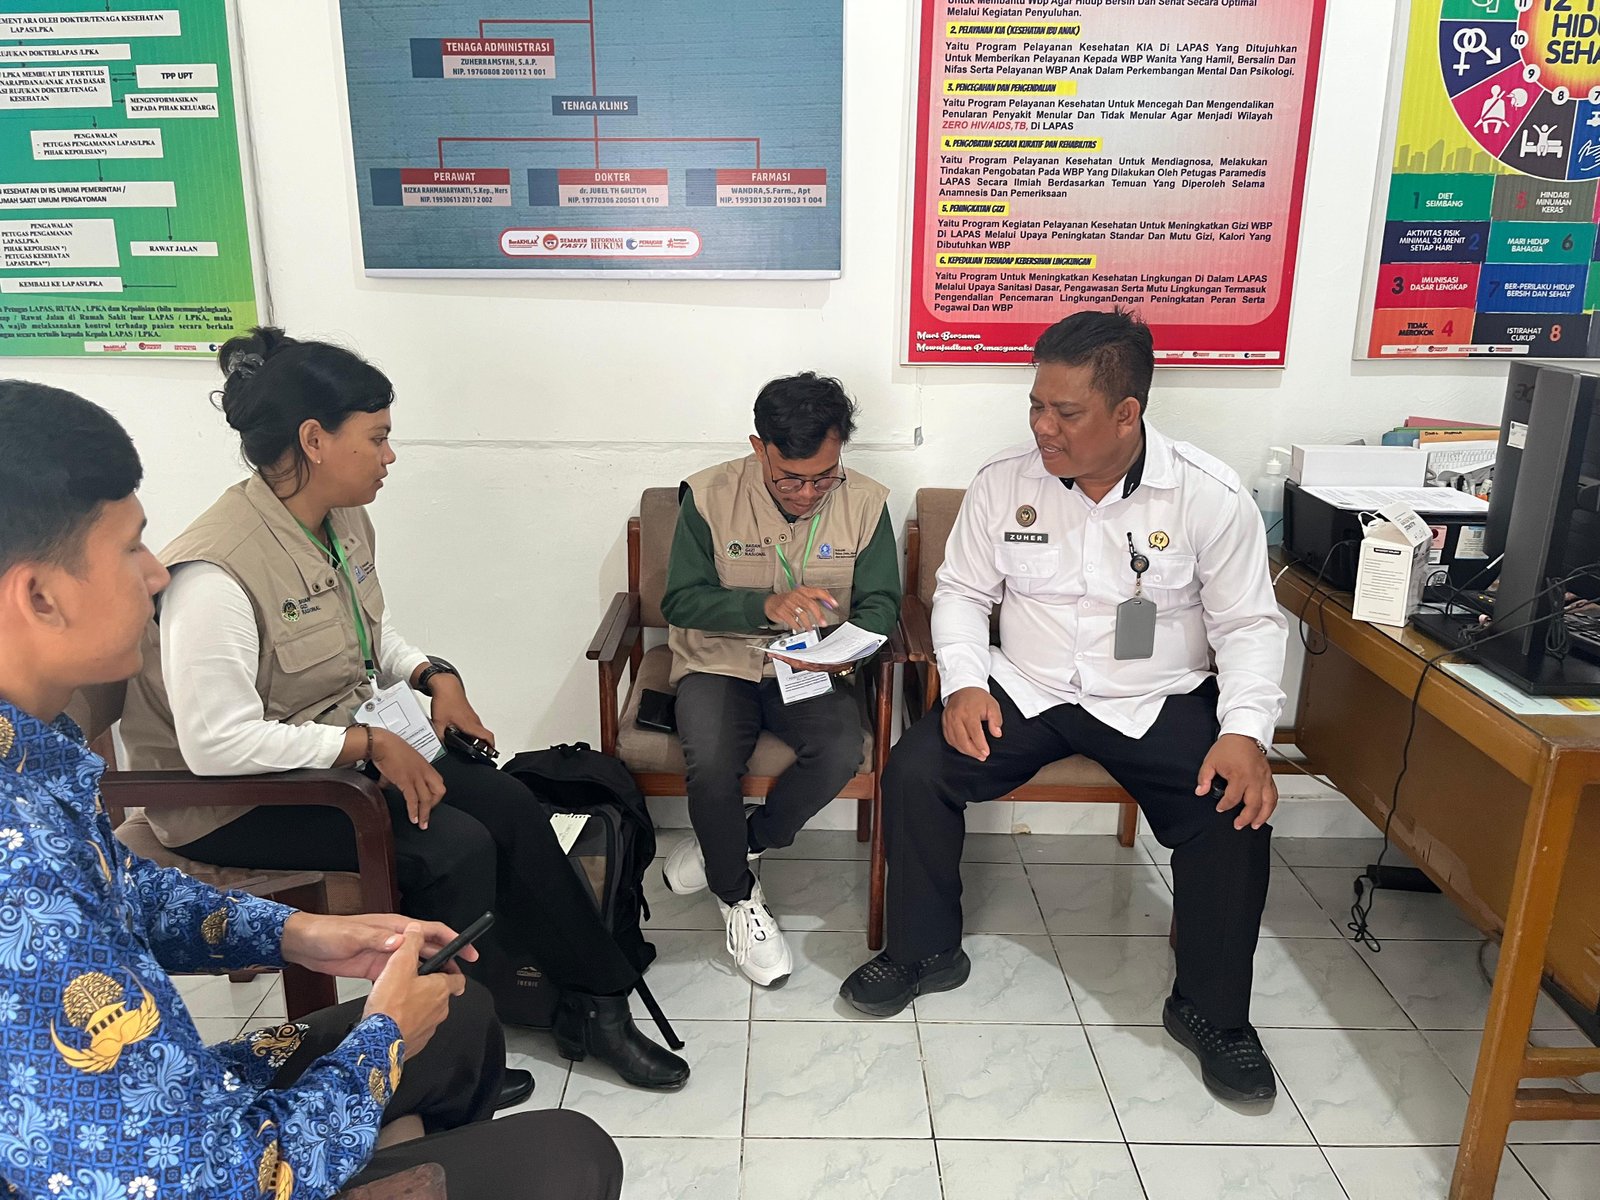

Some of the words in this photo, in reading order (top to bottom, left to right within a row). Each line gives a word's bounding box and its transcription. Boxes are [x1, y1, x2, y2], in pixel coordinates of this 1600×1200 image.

[947, 8, 980, 16] Melalui
[982, 8, 1023, 18] Kegiatan
[1025, 8, 1082, 18] Penyuluhan.
[958, 26, 993, 35] PELAYANAN
[994, 26, 1006, 34] KIA
[1006, 25, 1046, 36] (KESEHATAN
[1046, 26, 1058, 35] IBU
[1058, 25, 1081, 36] ANAK)
[1552, 13, 1600, 38] HID
[1513, 34, 1525, 45] 10
[446, 42, 482, 52] TENAGA
[484, 42, 550, 52] ADMINISTRASI
[946, 42, 970, 51] Yaitu
[976, 42, 1017, 53] Program
[1023, 42, 1073, 53] Pelayanan
[1079, 43, 1130, 52] Kesehatan
[1136, 43, 1153, 51] KIA
[1159, 43, 1170, 52] Di
[1176, 43, 1209, 52] LAPAS
[1215, 43, 1239, 54] Yang
[1246, 44, 1298, 55] Ditujuhkan
[461, 58, 517, 66] ZUHERRAMSYAH,
[518, 58, 537, 66] S.A.P.
[945, 54, 972, 63] Untuk
[974, 54, 1030, 63] Memberikan
[1033, 54, 1081, 66] Pelayanan
[1083, 54, 1118, 66] Kepada
[1121, 55, 1143, 63] WBP
[1146, 55, 1177, 64] Wanita
[1179, 55, 1203, 66] Yang
[1206, 55, 1234, 65] Hamil,
[1237, 55, 1275, 64] Bersalin
[1278, 56, 1296, 65] Dan
[161, 72, 176, 80] TPP
[178, 72, 193, 80] UPT
[453, 68, 466, 76] NIP.
[501, 68, 526, 76] 200112
[528, 68, 532, 76] 1
[533, 68, 546, 76] 001
[1528, 68, 1535, 79] 9
[1557, 90, 1565, 101] 8
[131, 104, 157, 112] KEPADA
[158, 104, 179, 112] PIHAK
[180, 104, 215, 112] KELUARGA
[562, 101, 597, 111] TENAGA
[599, 101, 629, 111] KLINIS
[942, 121, 968, 129] ZERO
[1031, 122, 1041, 130] Di
[1042, 122, 1074, 130] LAPAS
[434, 172, 476, 182] PERAWAT
[594, 172, 631, 182] DOKTER
[751, 172, 791, 182] FARMASI
[473, 187, 494, 195] S.Kep.,
[798, 187, 811, 195] Apt
[720, 196, 734, 204] NIP.
[735, 196, 772, 204] 19930130
[773, 196, 801, 204] 201903
[802, 196, 806, 204] 1
[807, 196, 823, 204] 004
[1413, 192, 1420, 209] 1
[1425, 200, 1464, 208] SEIMBANG
[1515, 192, 1528, 209] 5
[937, 241, 987, 249] Dibutuhkan
[989, 241, 1011, 249] WBP
[1468, 233, 1480, 250] 2
[1561, 234, 1574, 251] 6
[1391, 277, 1404, 295] 3
[1488, 281, 1500, 298] 7
[1507, 290, 1531, 298] BERSIH
[1532, 290, 1547, 298] DAN
[1548, 290, 1571, 298] SEHAT
[934, 303, 970, 313] Pegawai
[972, 304, 990, 312] Dan
[992, 304, 1014, 312] WBP
[1441, 320, 1454, 337] 4
[1549, 325, 1562, 342] 8
[916, 332, 939, 340] Mari
[941, 332, 981, 340] Bersama
[1510, 334, 1536, 342] CUKUP
[916, 343, 972, 352] Mewujudkan
[1009, 534, 1043, 542] ZUHER
